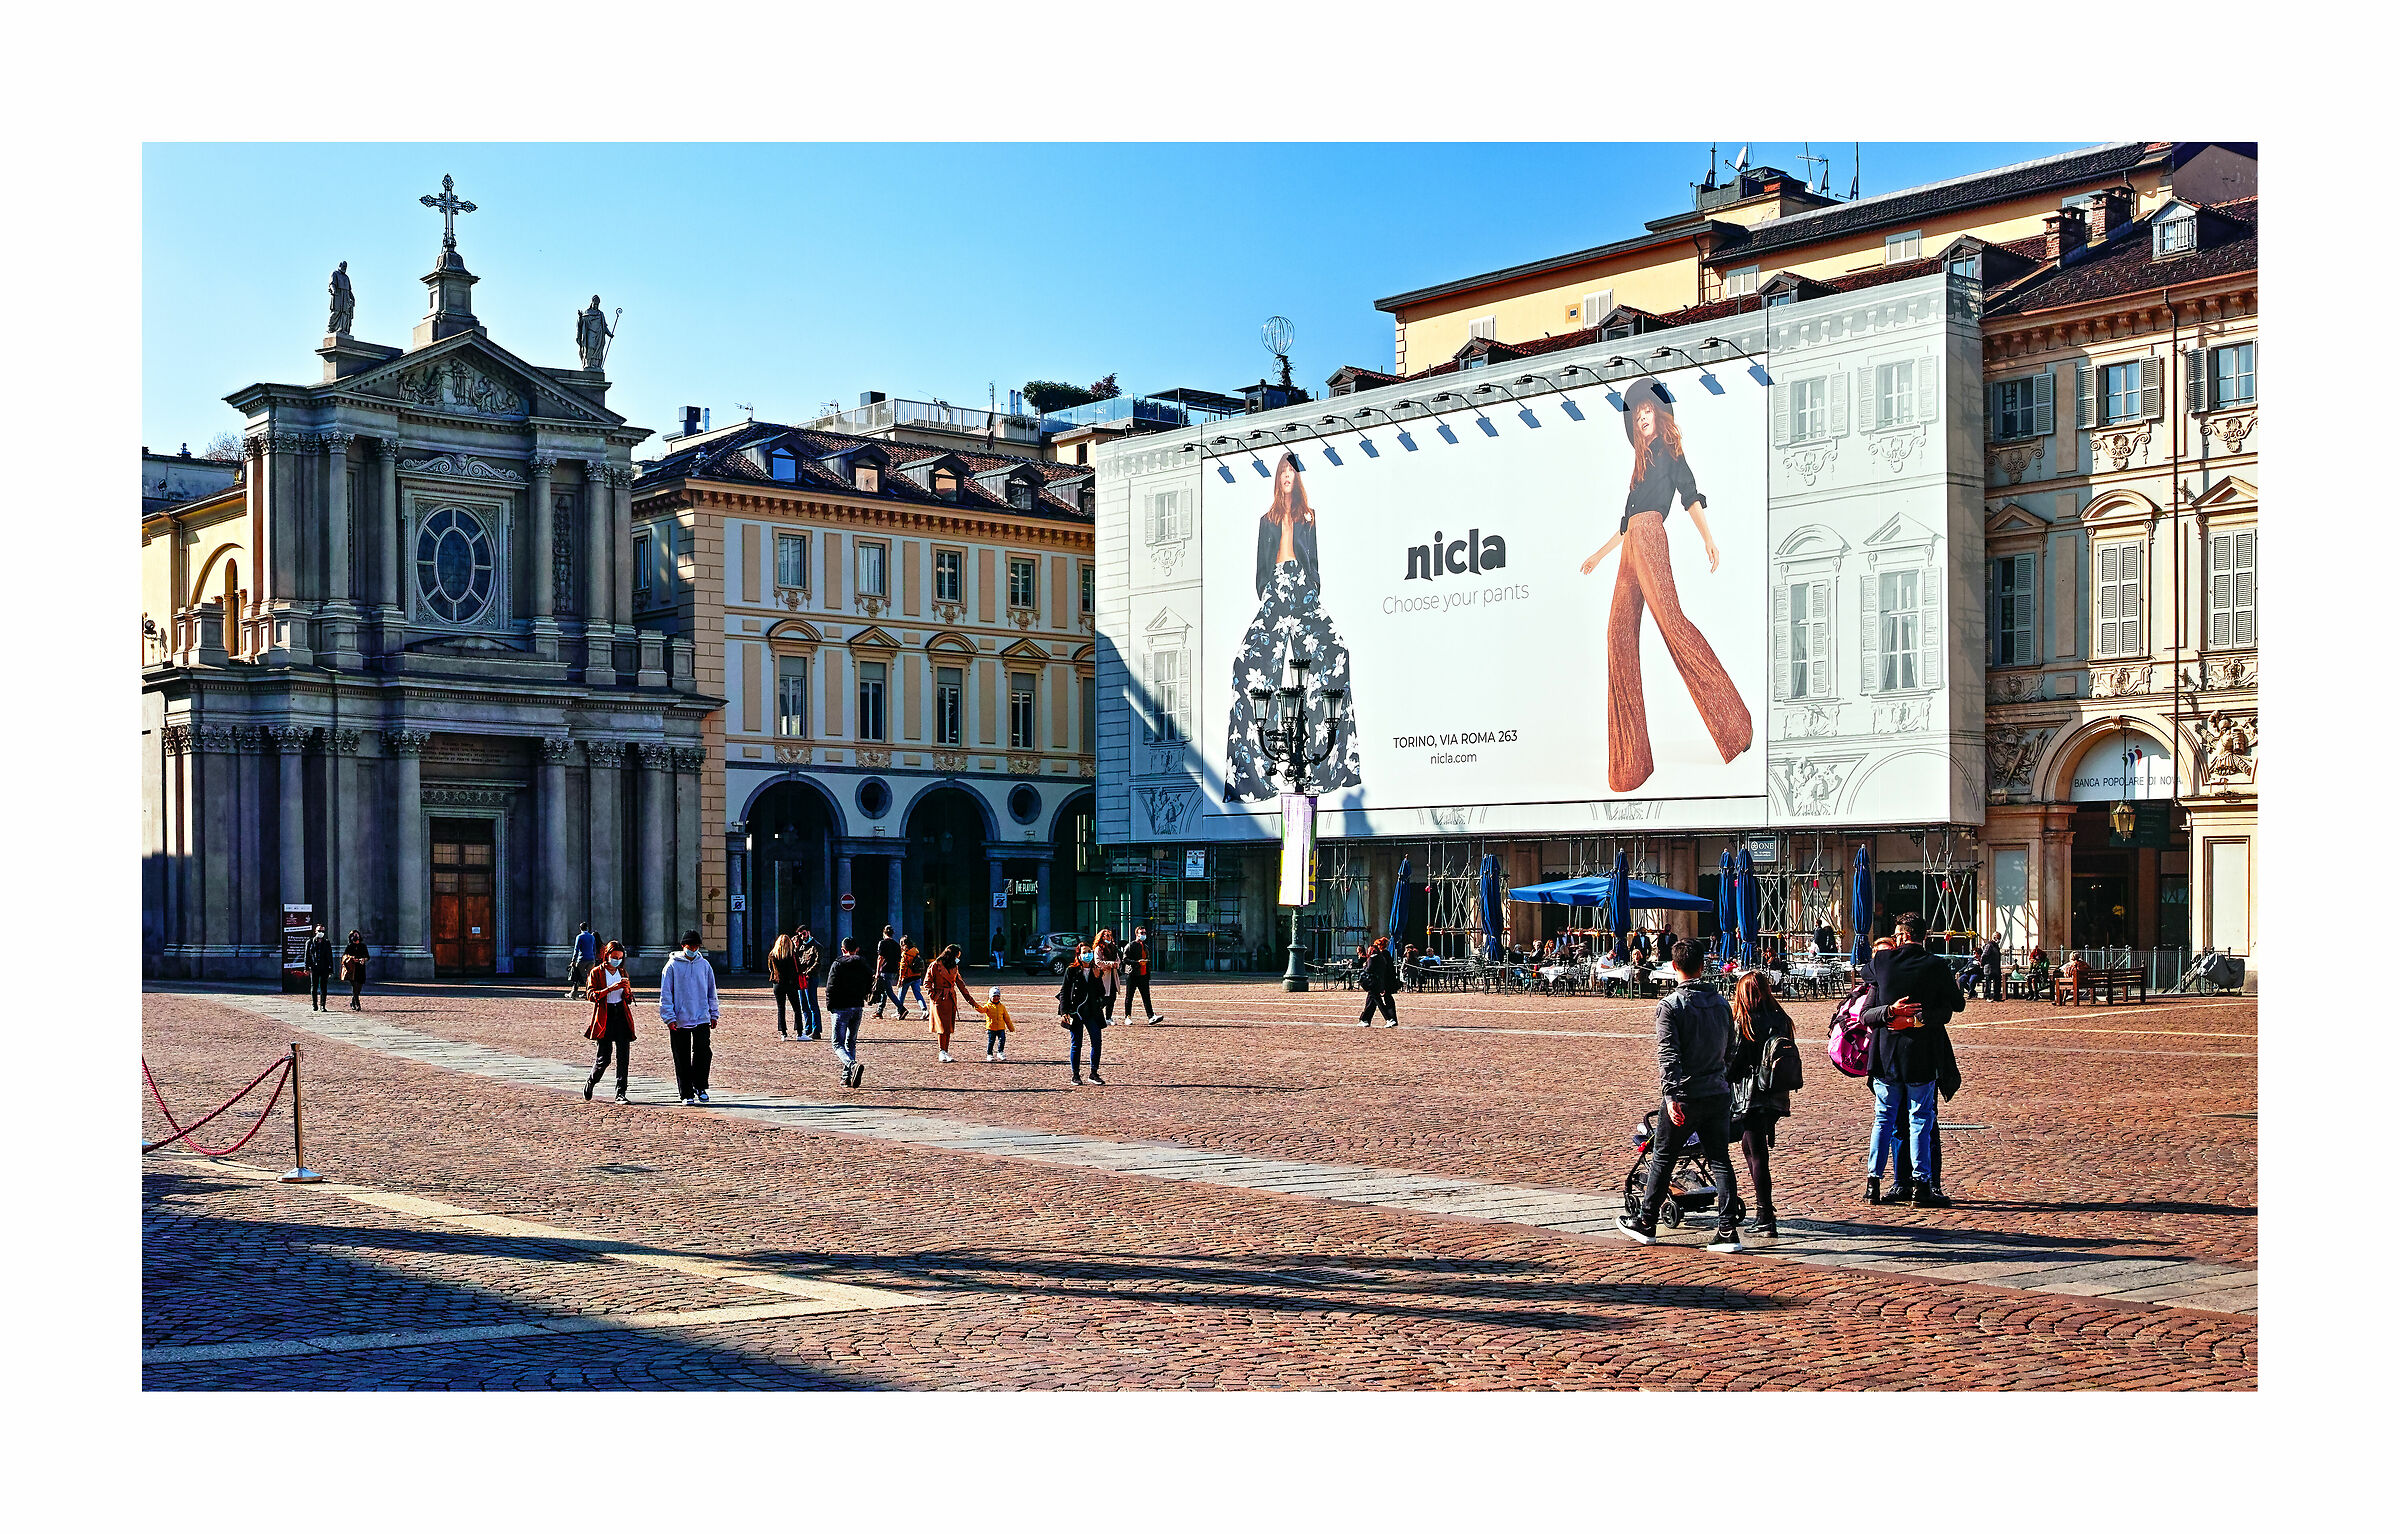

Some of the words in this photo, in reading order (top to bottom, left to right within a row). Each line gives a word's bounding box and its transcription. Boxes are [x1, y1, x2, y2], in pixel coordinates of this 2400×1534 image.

[1404, 528, 1507, 581] nicla
[1382, 594, 1440, 615] Choose
[1443, 589, 1479, 613] your
[1483, 583, 1530, 608] pants
[1392, 735, 1438, 749] TORINO,
[1440, 733, 1459, 747] VIA
[1461, 731, 1496, 745] ROMA
[1498, 730, 1518, 743] 263
[1430, 752, 1478, 765] nicla.com
[2074, 777, 2100, 788] BANCA
[2148, 776, 2157, 786] DI
[1758, 842, 1774, 850] ONE
